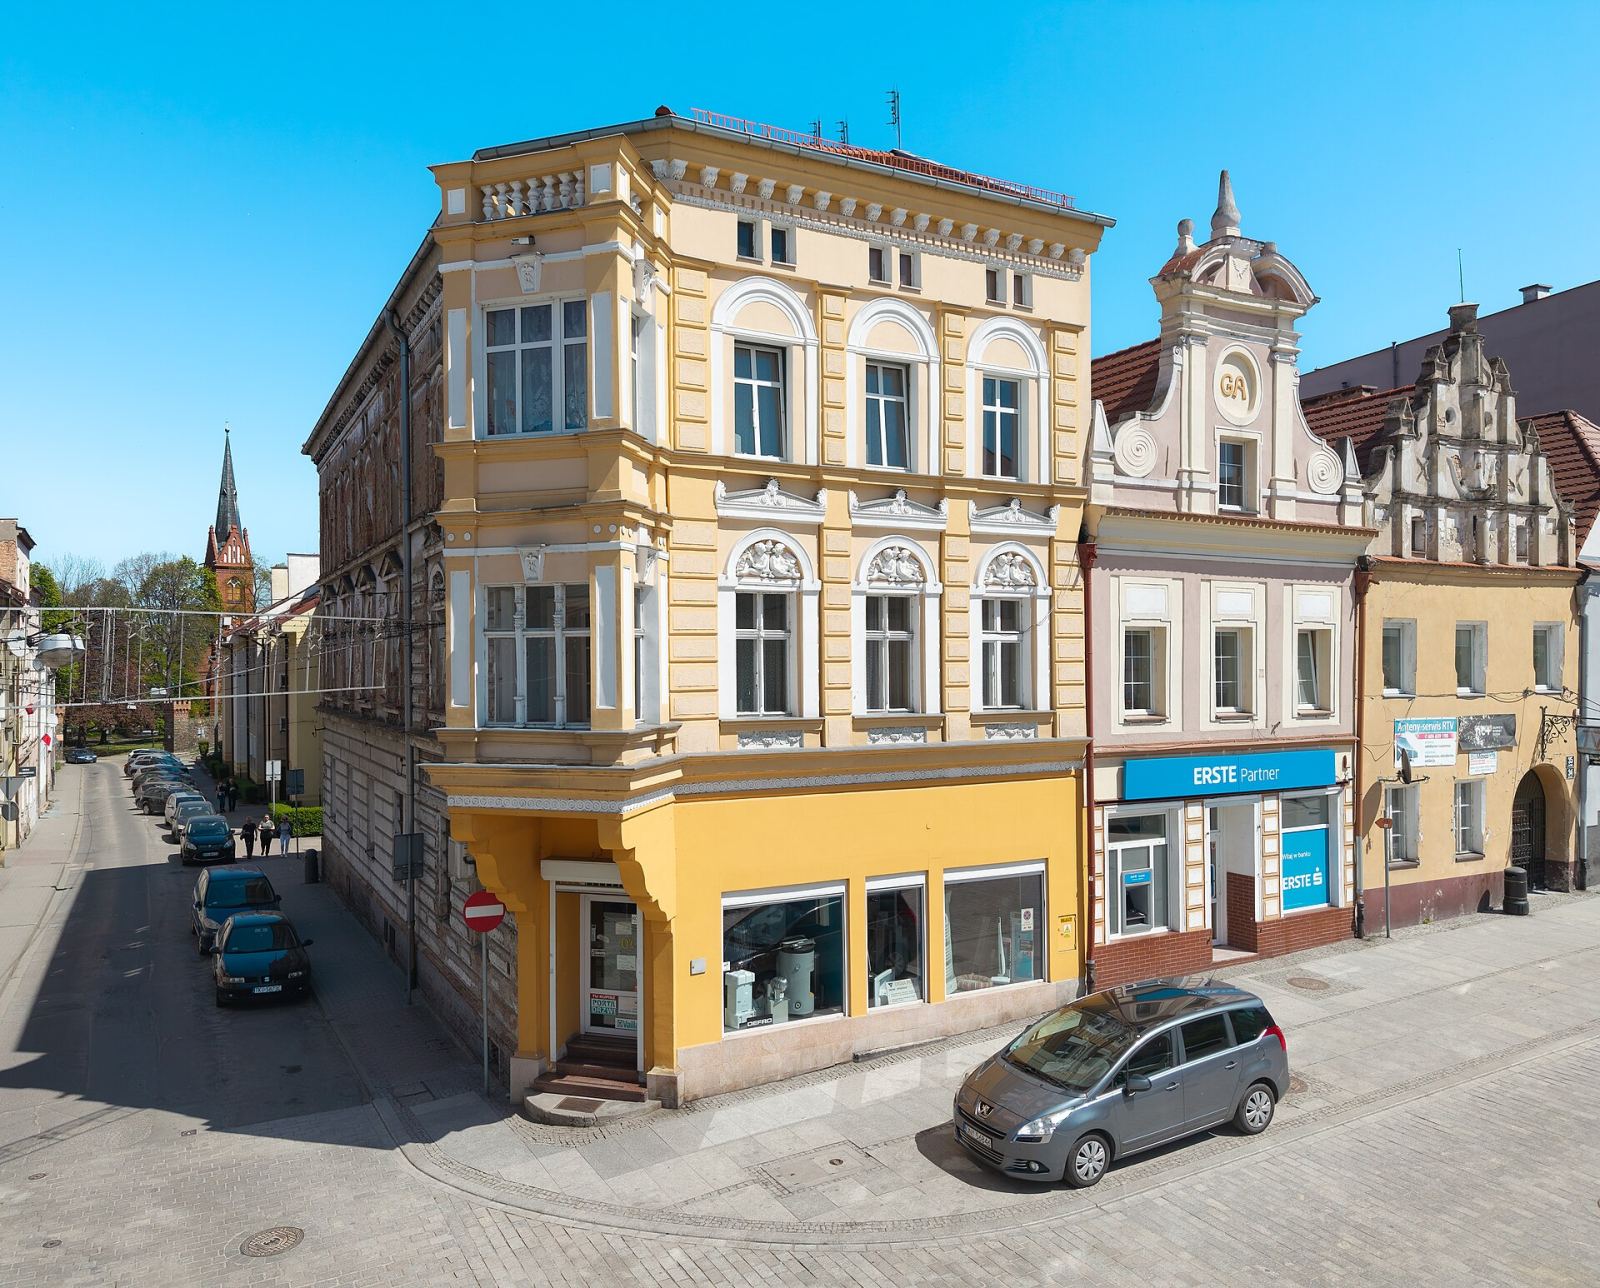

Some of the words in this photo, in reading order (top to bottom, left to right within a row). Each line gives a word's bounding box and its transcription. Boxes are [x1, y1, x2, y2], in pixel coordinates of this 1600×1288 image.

[1442, 720, 1455, 730] RTV
[1193, 765, 1237, 785] ERSTE
[1240, 767, 1280, 783] Partner
[1282, 873, 1312, 891] ERSTE
[747, 1017, 772, 1027] DEFRO
